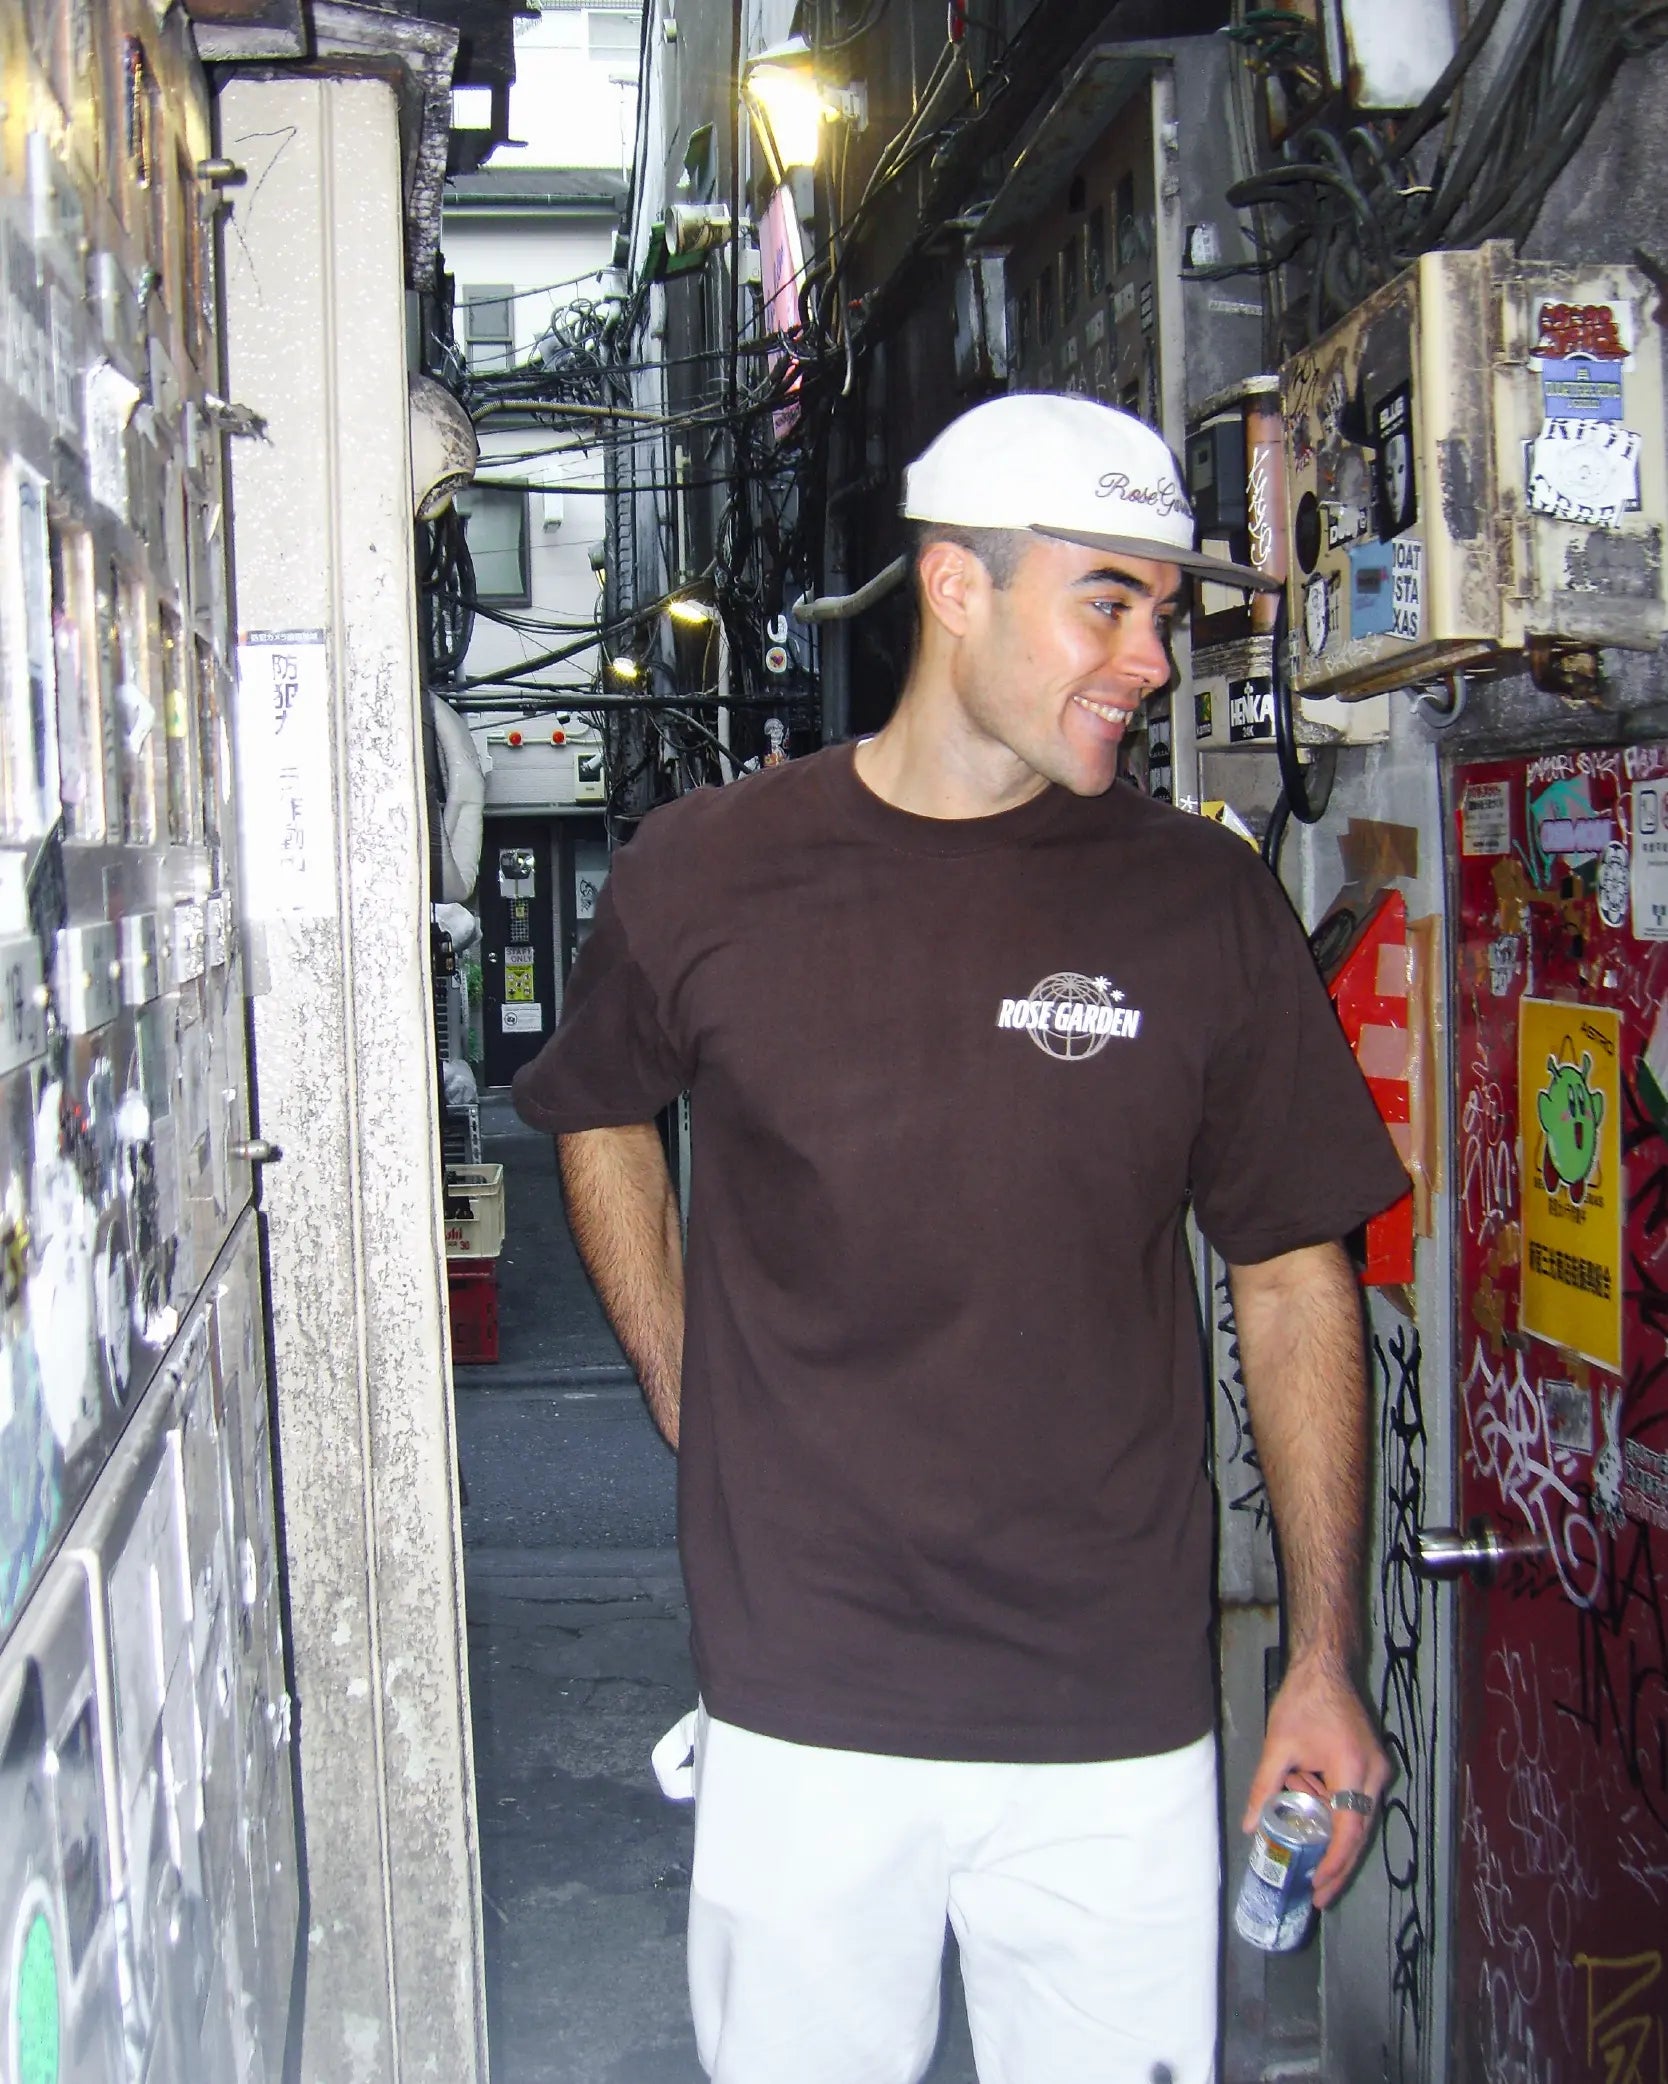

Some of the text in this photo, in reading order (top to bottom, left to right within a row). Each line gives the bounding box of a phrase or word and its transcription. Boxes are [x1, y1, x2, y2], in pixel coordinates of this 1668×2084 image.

[1095, 472, 1158, 505] Rose
[1393, 575, 1420, 604] STA
[510, 955, 532, 963] ONLY
[997, 998, 1141, 1039] ROSE GARDEN
